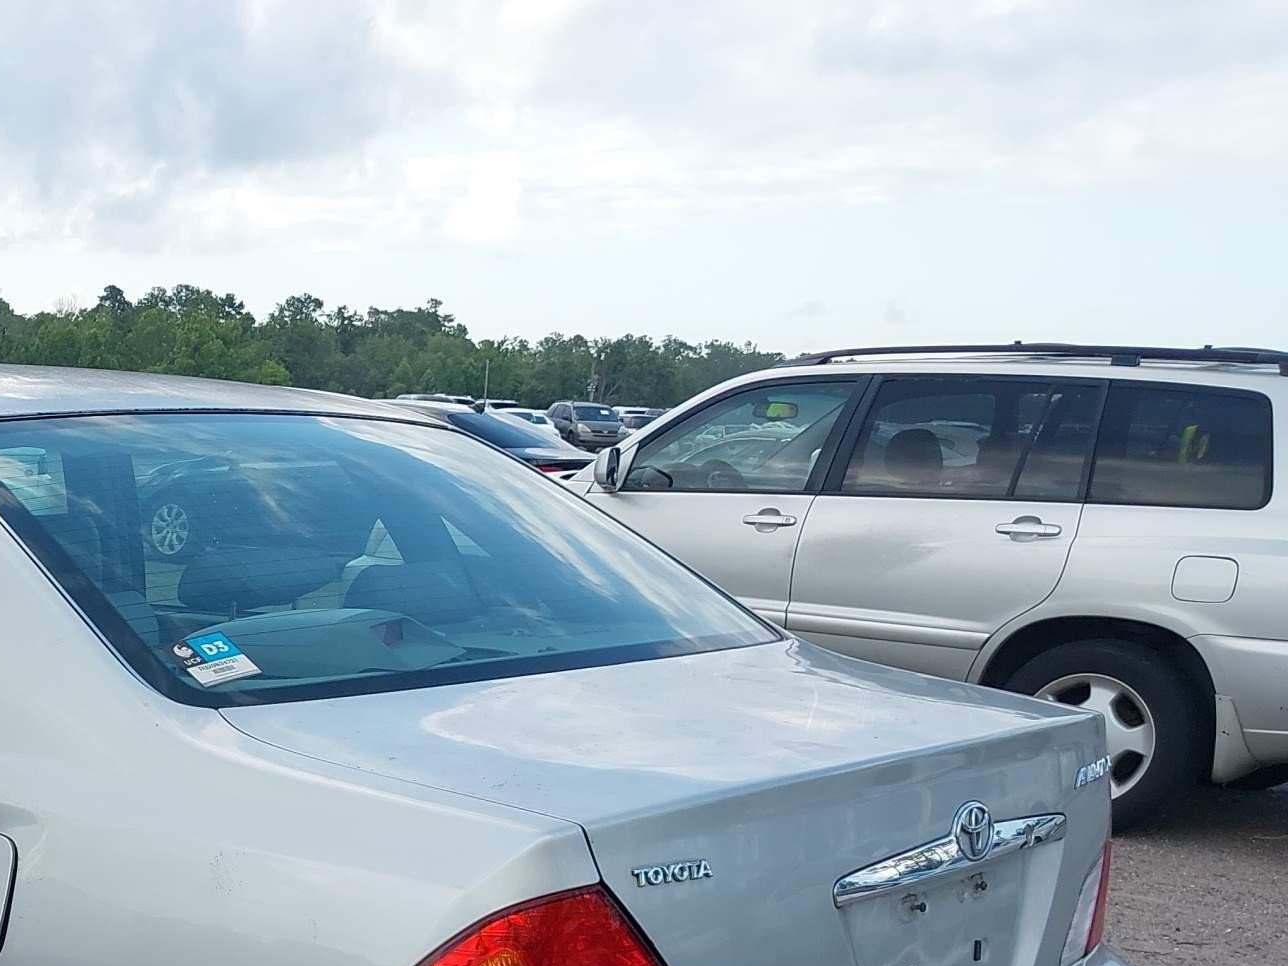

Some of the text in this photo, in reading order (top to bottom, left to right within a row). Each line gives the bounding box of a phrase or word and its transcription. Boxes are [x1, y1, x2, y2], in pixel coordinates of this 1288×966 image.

[200, 640, 229, 656] D3
[183, 656, 202, 666] UCF
[631, 859, 713, 887] TOYOTA
